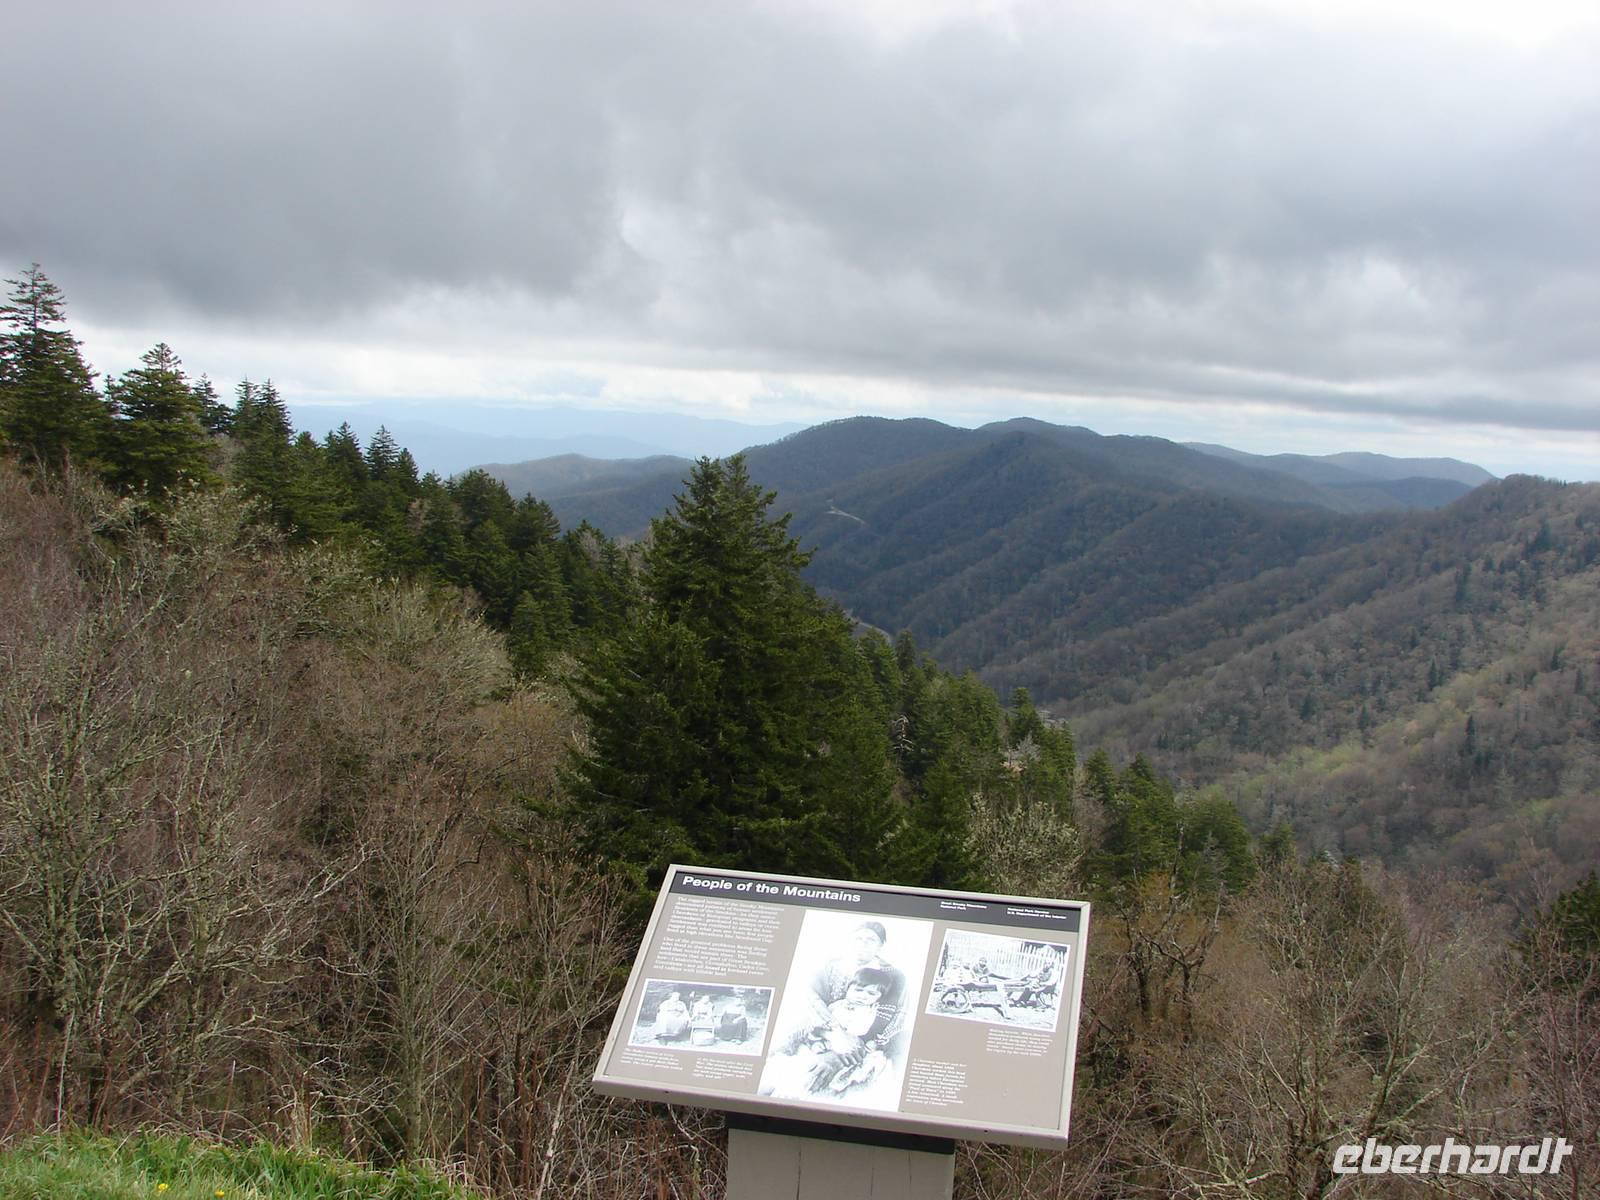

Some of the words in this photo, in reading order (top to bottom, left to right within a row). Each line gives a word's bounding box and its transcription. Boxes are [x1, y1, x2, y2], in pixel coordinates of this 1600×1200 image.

[682, 875, 732, 890] People
[736, 882, 752, 892] of
[755, 883, 779, 894] the
[783, 885, 861, 902] Mountains
